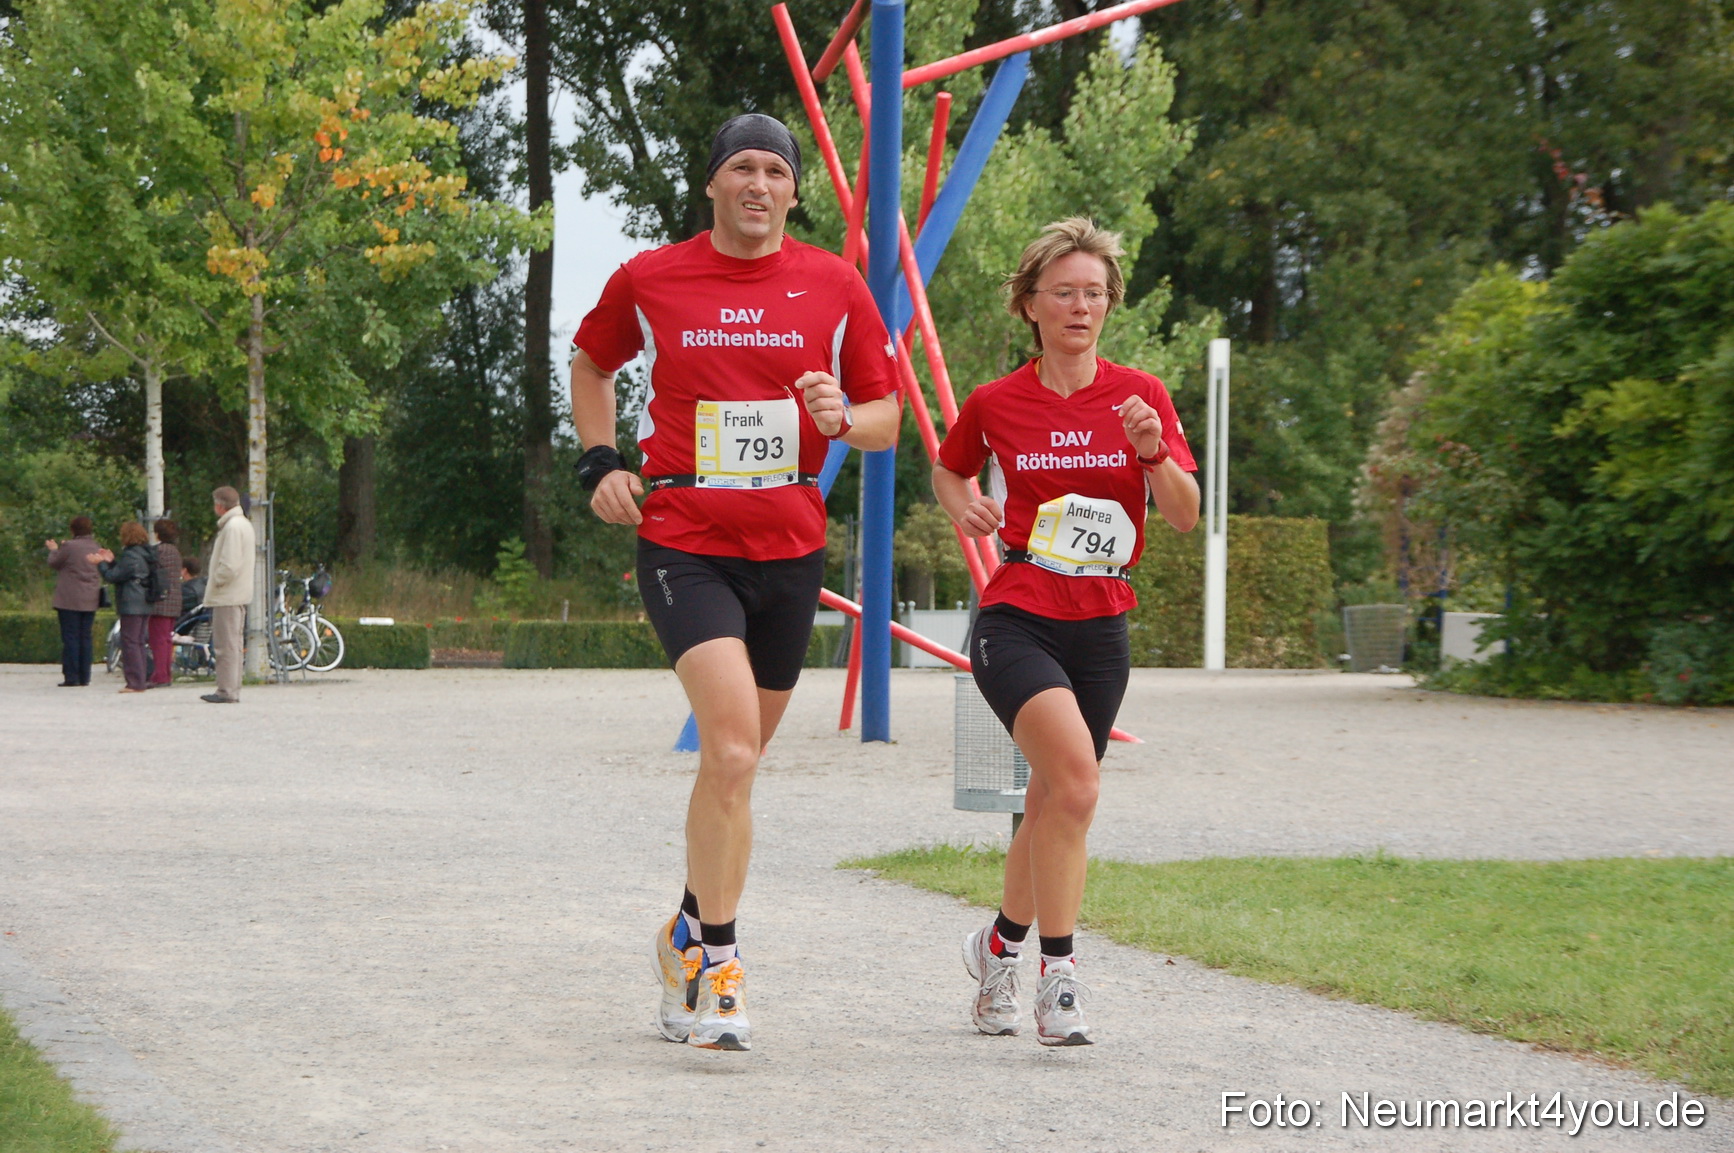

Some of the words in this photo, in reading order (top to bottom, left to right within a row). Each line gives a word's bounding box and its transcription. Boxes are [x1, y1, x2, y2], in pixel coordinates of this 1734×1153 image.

[720, 308, 765, 324] DAV
[682, 328, 804, 348] Röthenbach
[724, 410, 764, 427] Frank
[700, 436, 707, 448] C
[1050, 430, 1093, 448] DAV
[735, 436, 785, 462] 793
[1016, 450, 1127, 471] Röthenbach
[763, 470, 797, 483] PFLEIDER
[1066, 502, 1112, 524] Andrea
[1038, 519, 1046, 528] C
[1070, 526, 1117, 558] 794
